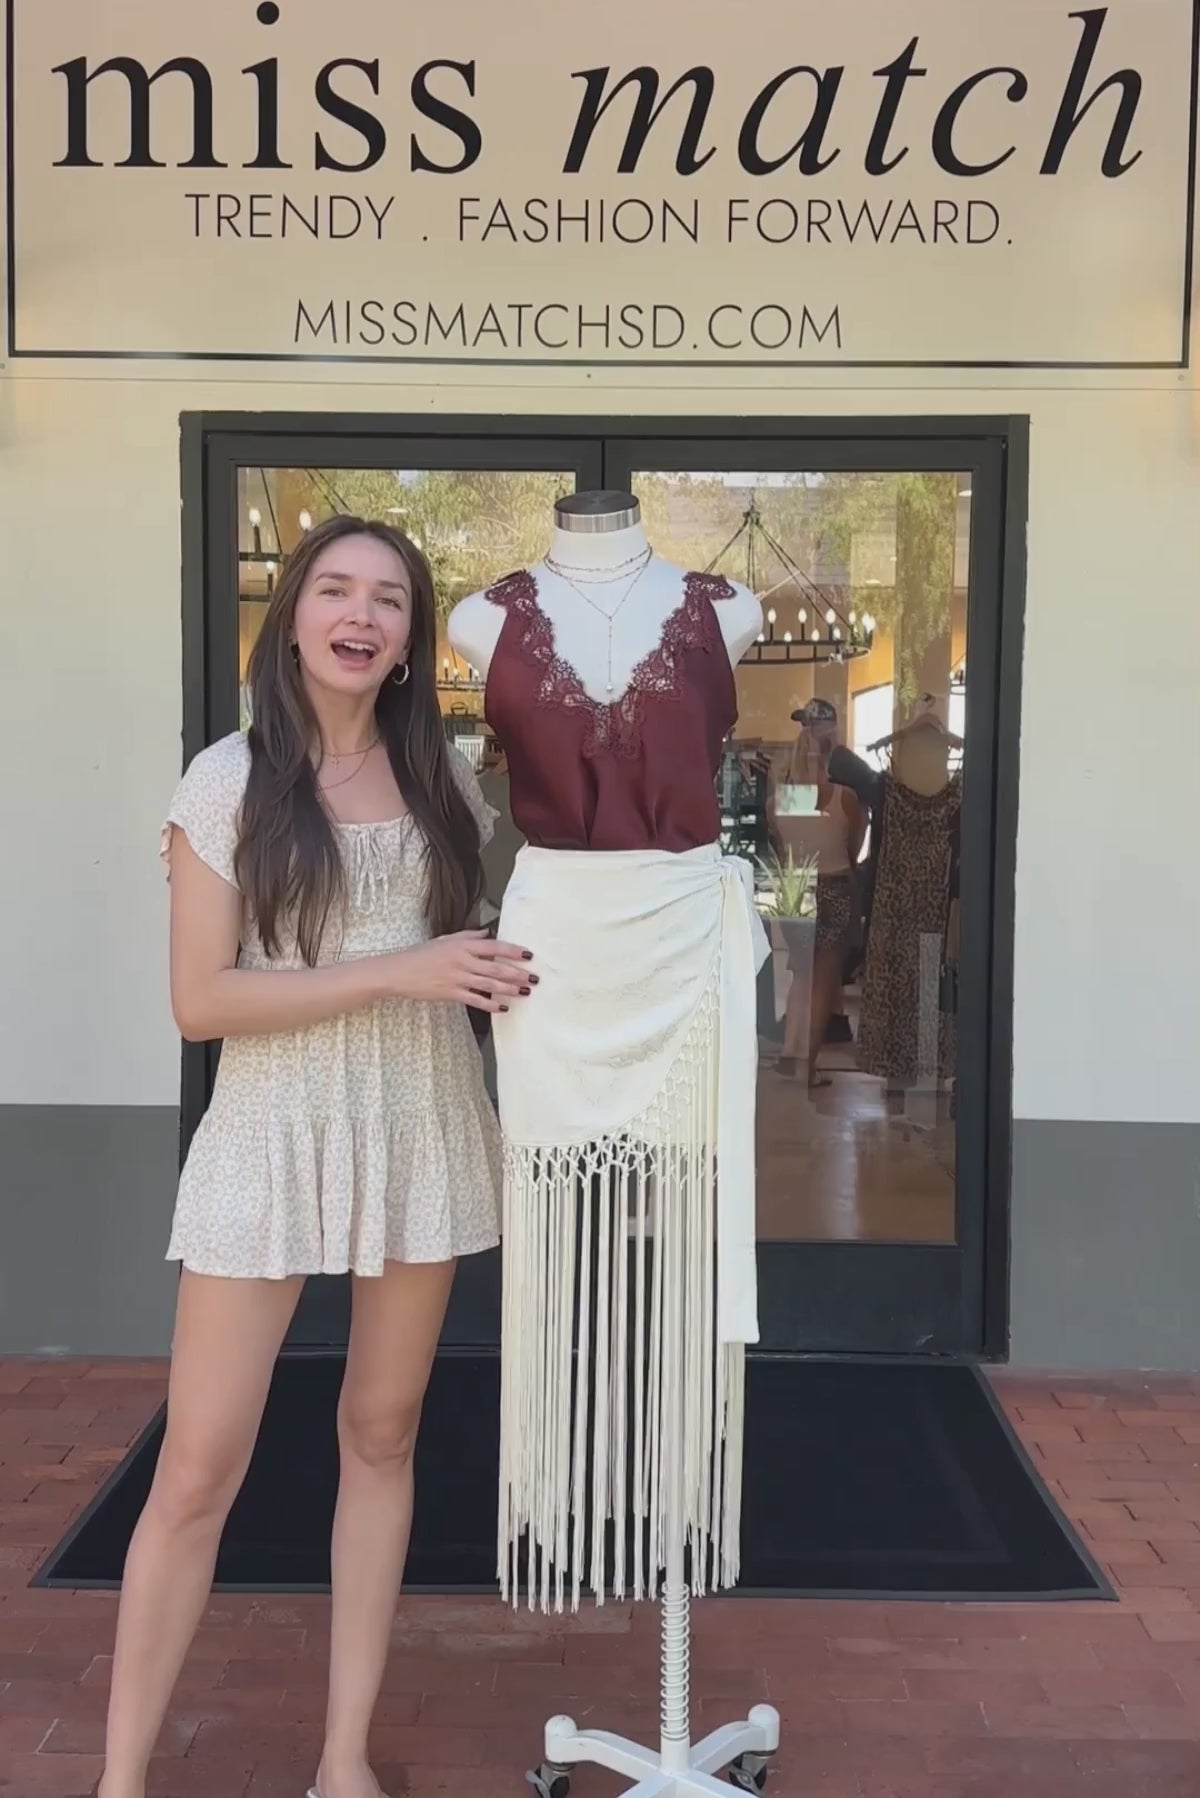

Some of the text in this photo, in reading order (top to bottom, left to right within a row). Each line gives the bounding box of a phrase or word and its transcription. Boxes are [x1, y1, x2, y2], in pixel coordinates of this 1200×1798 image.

[50, 2, 1143, 178] miss match
[184, 194, 395, 239] TRENDY
[458, 198, 699, 243] FASHION
[728, 200, 1013, 245] FORWARD.
[294, 300, 842, 349] MISSMATCHSD.COM
